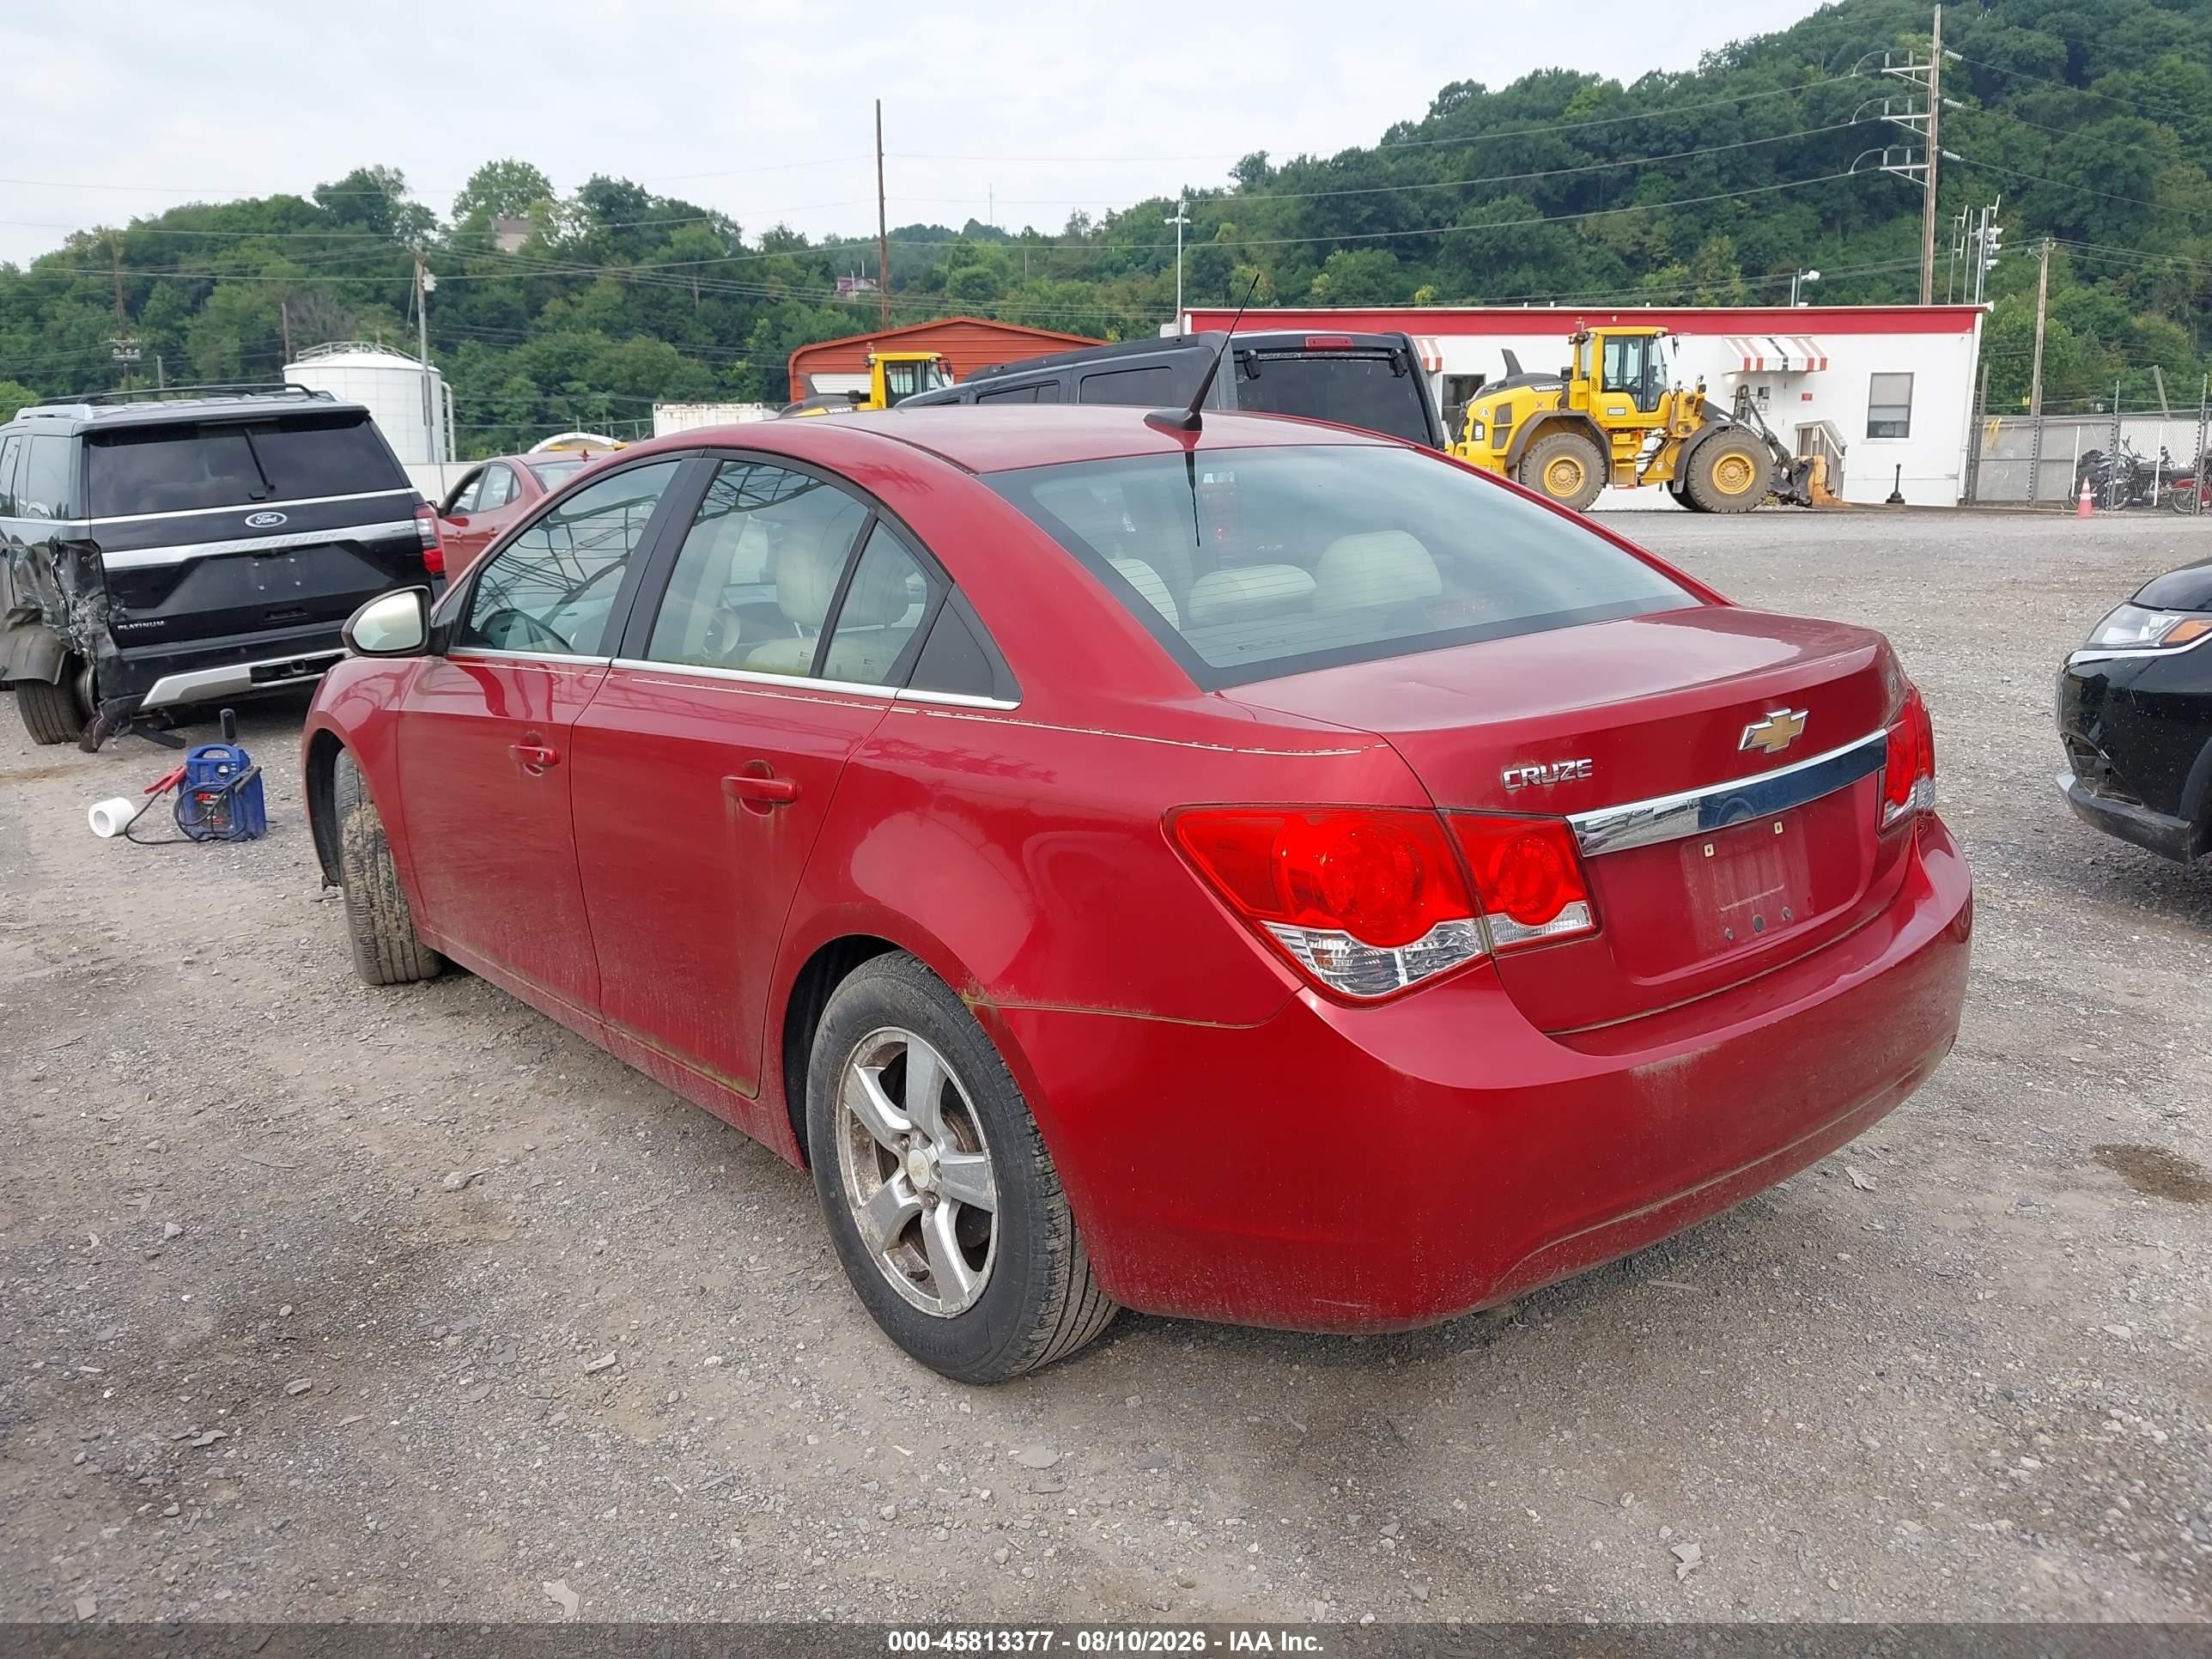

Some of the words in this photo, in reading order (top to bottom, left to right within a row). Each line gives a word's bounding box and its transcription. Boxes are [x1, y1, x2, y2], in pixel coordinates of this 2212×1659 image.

[255, 514, 277, 525] Ford
[199, 532, 337, 554] EXPEDITION
[117, 620, 166, 631] PLATINUM
[1503, 758, 1594, 790] CRUZE
